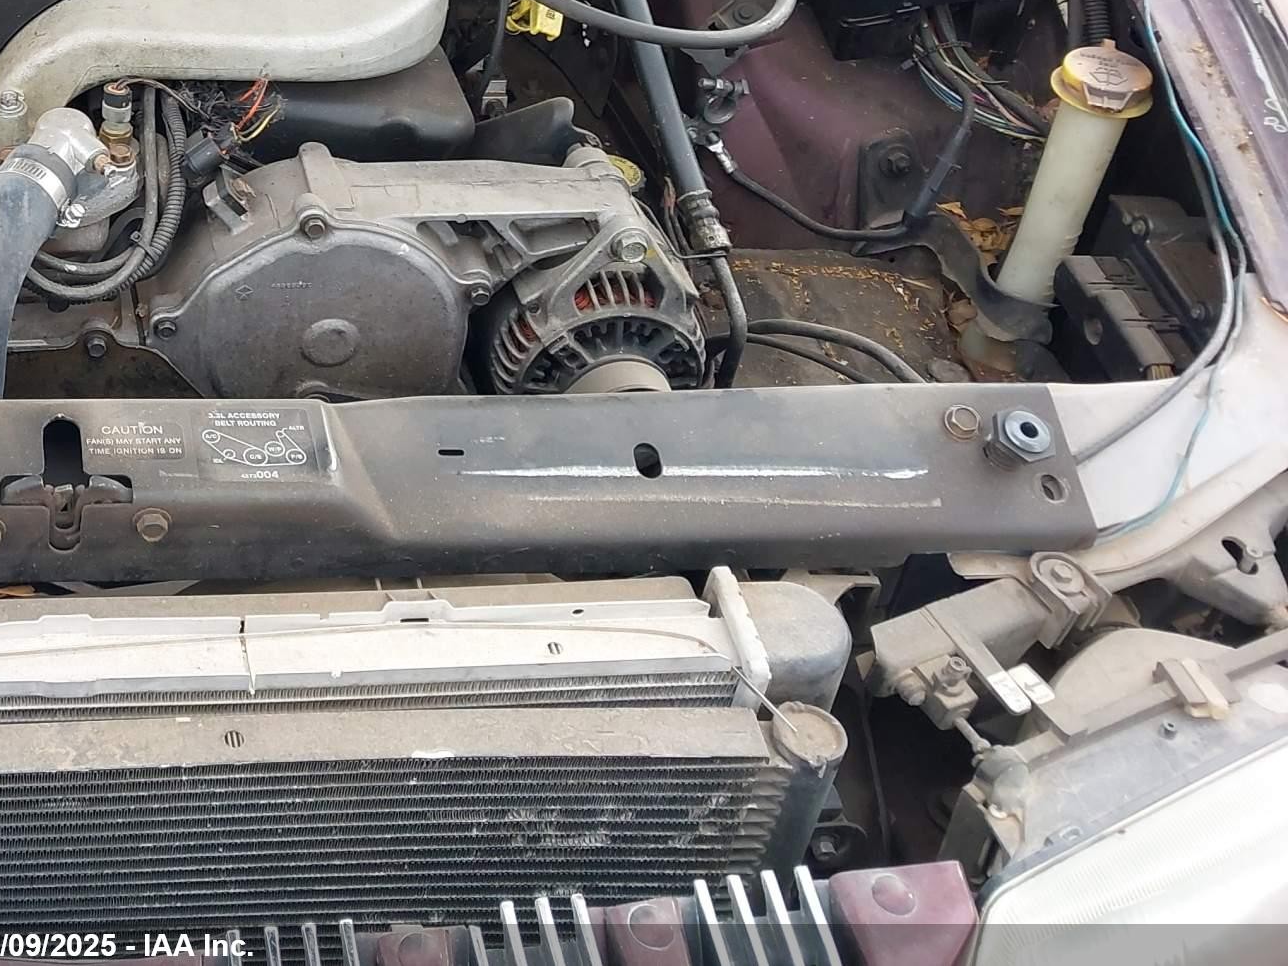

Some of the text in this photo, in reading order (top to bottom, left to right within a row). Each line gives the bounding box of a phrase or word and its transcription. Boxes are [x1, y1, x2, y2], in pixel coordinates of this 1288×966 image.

[237, 419, 277, 427] ROUTING
[101, 424, 163, 435] CAUTION
[86, 437, 114, 446] FAN(S)
[135, 437, 161, 445] START
[163, 436, 181, 444] ANY
[113, 447, 154, 455] IGNITION
